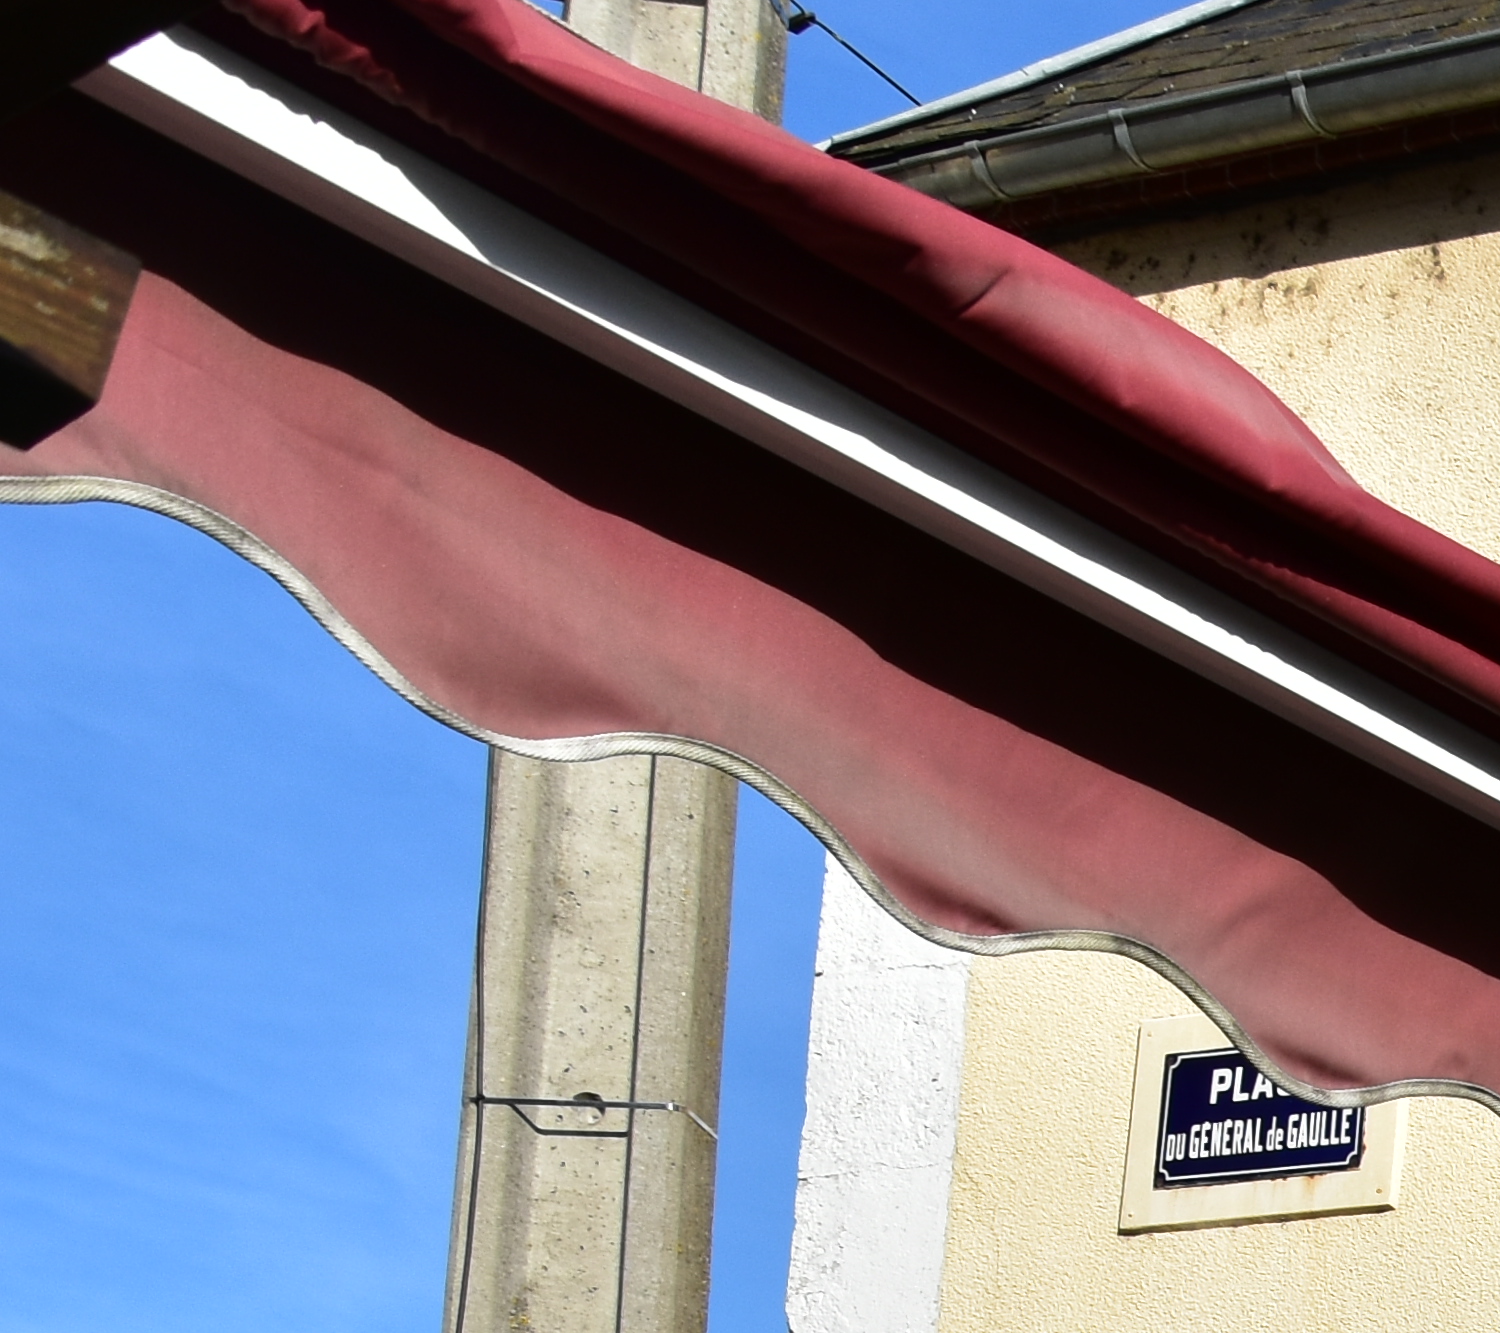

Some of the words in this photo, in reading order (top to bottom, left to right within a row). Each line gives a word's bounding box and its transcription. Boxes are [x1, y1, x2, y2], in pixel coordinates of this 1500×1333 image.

[1209, 1066, 1292, 1105] PLA
[1165, 1133, 1187, 1162] DU
[1188, 1116, 1264, 1160] GÉNÉRAL
[1266, 1116, 1284, 1152] de
[1286, 1108, 1353, 1150] GAULLE
